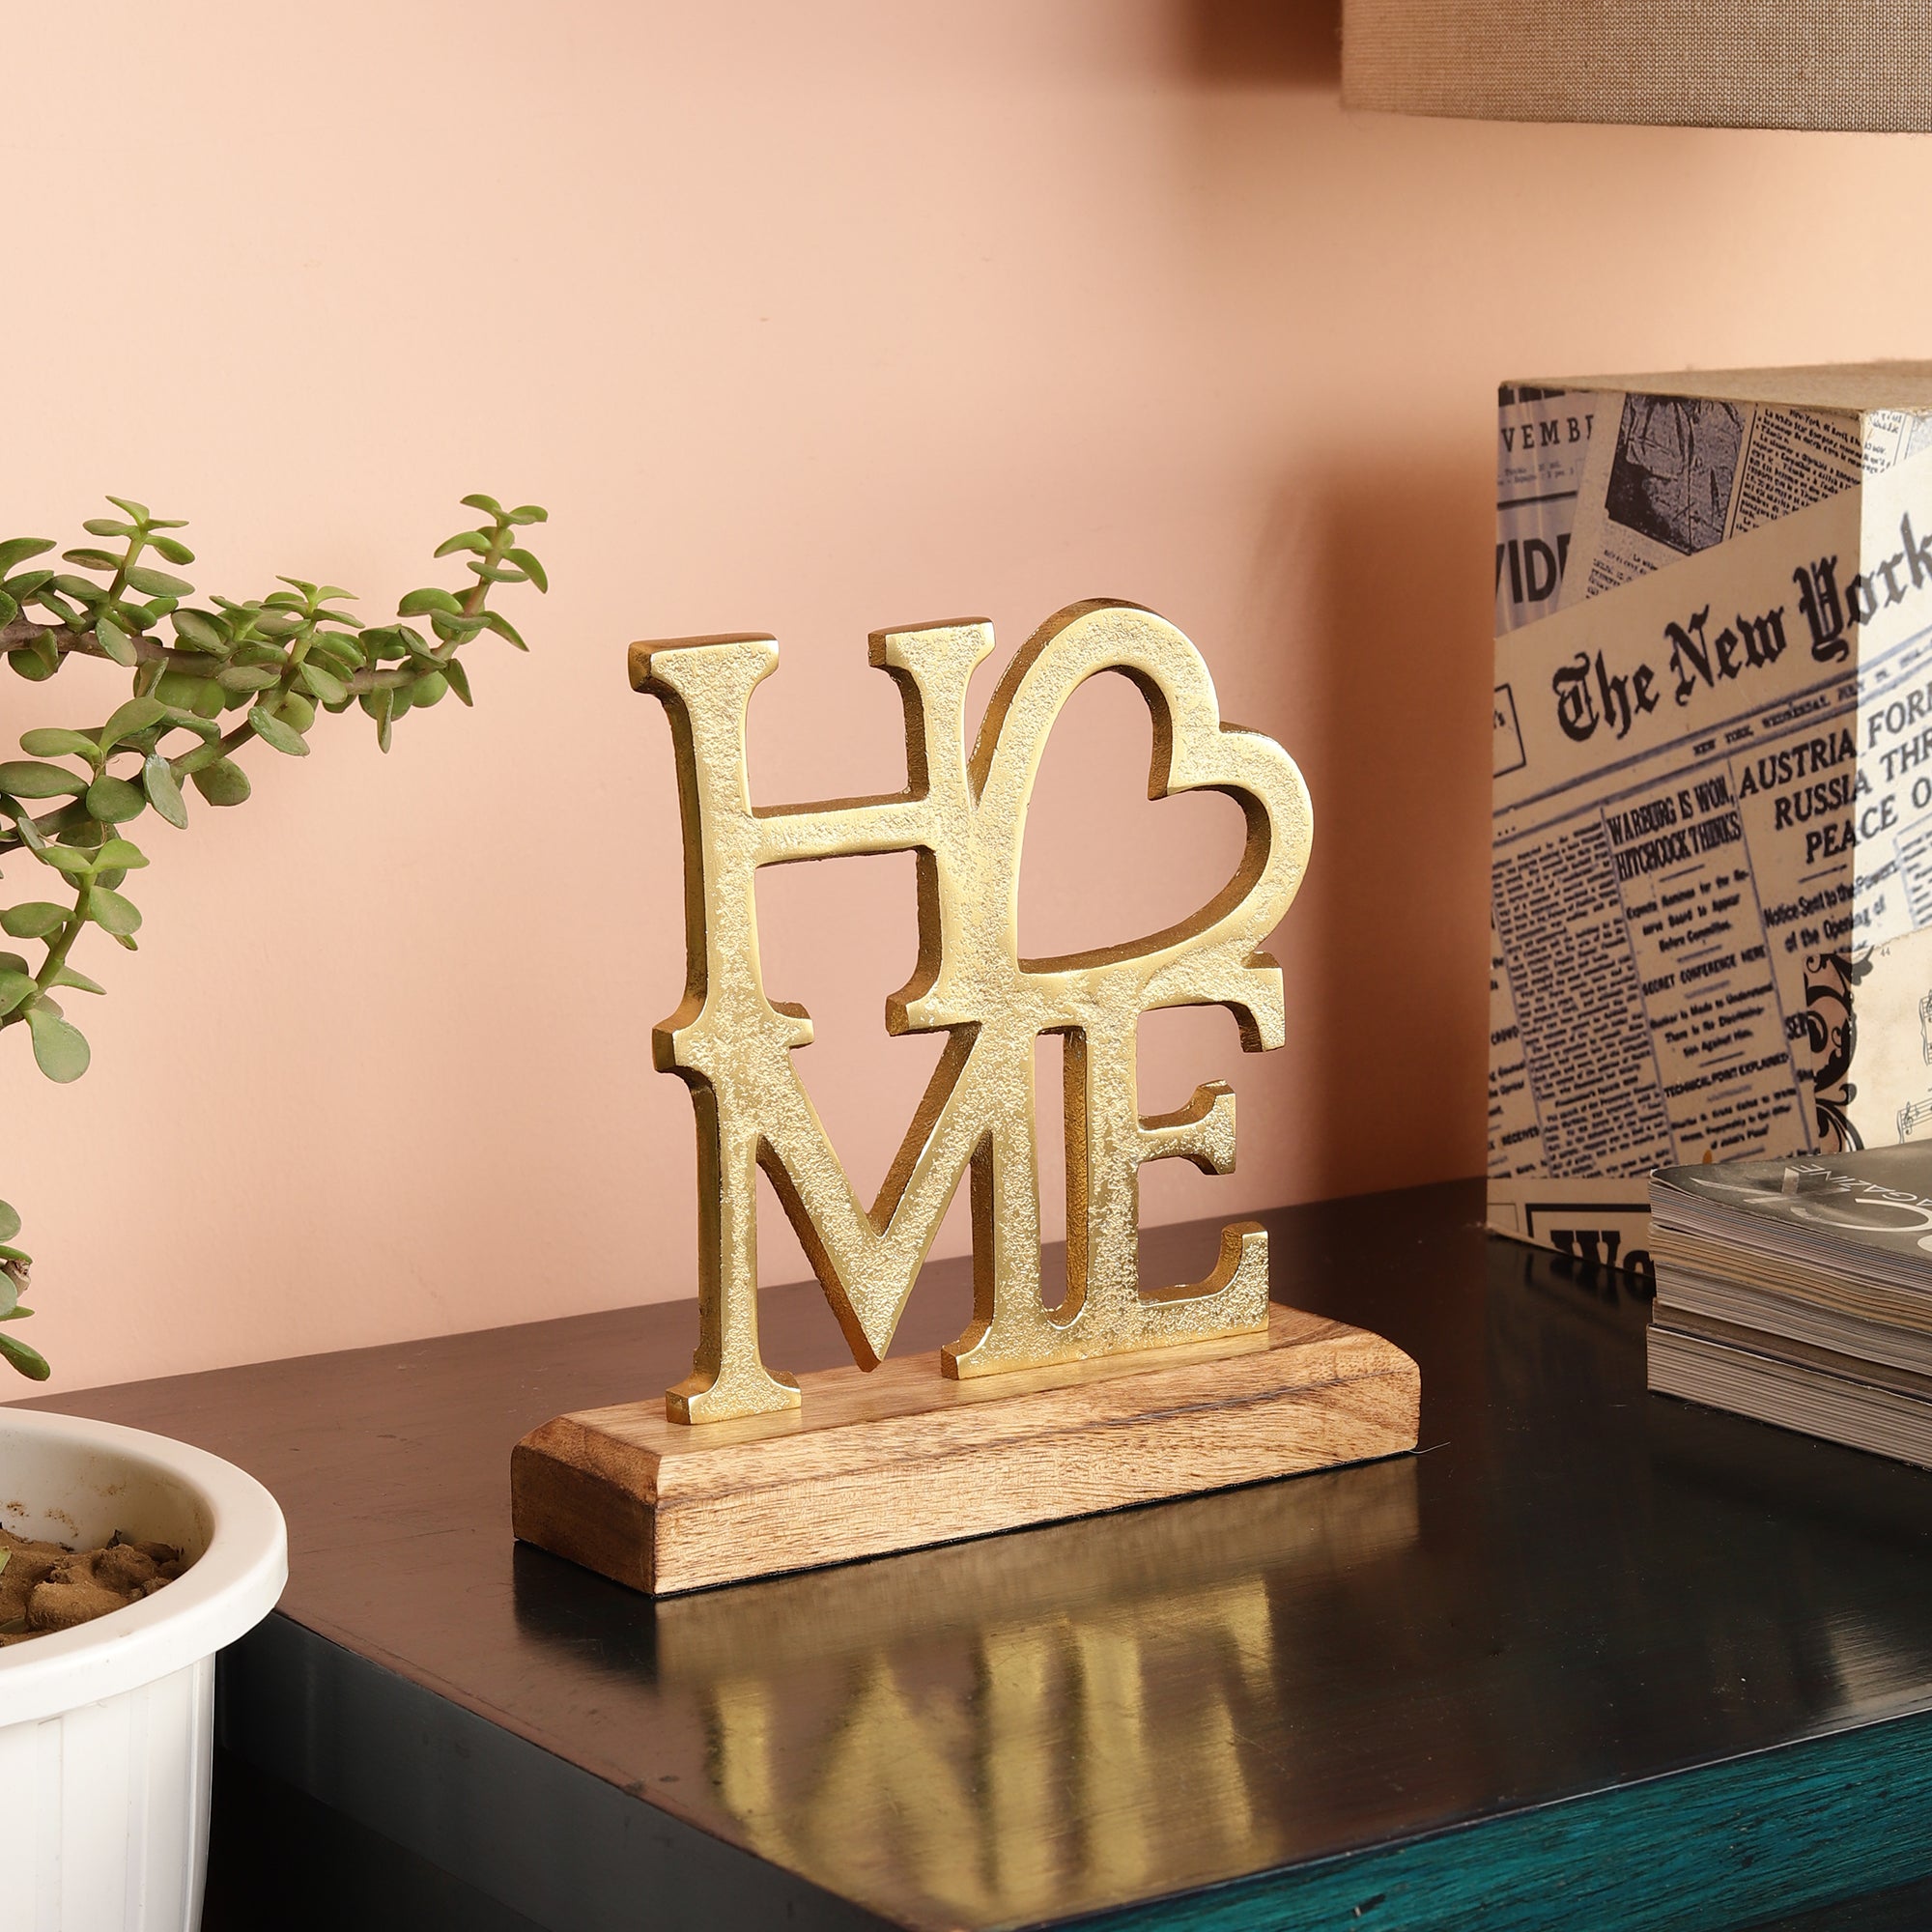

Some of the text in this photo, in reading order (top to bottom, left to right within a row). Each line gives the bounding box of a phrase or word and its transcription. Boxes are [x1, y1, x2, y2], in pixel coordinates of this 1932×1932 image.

[1552, 510, 1932, 741] The New York
[1739, 728, 1857, 799] AUSTRIA
[1607, 797, 1677, 846] WARBURG
[1678, 790, 1693, 820] IS
[1775, 769, 1872, 831] RUSSIA
[1806, 794, 1899, 864] PEACE
[1615, 810, 1742, 881] HITCHCOCK THINKS
